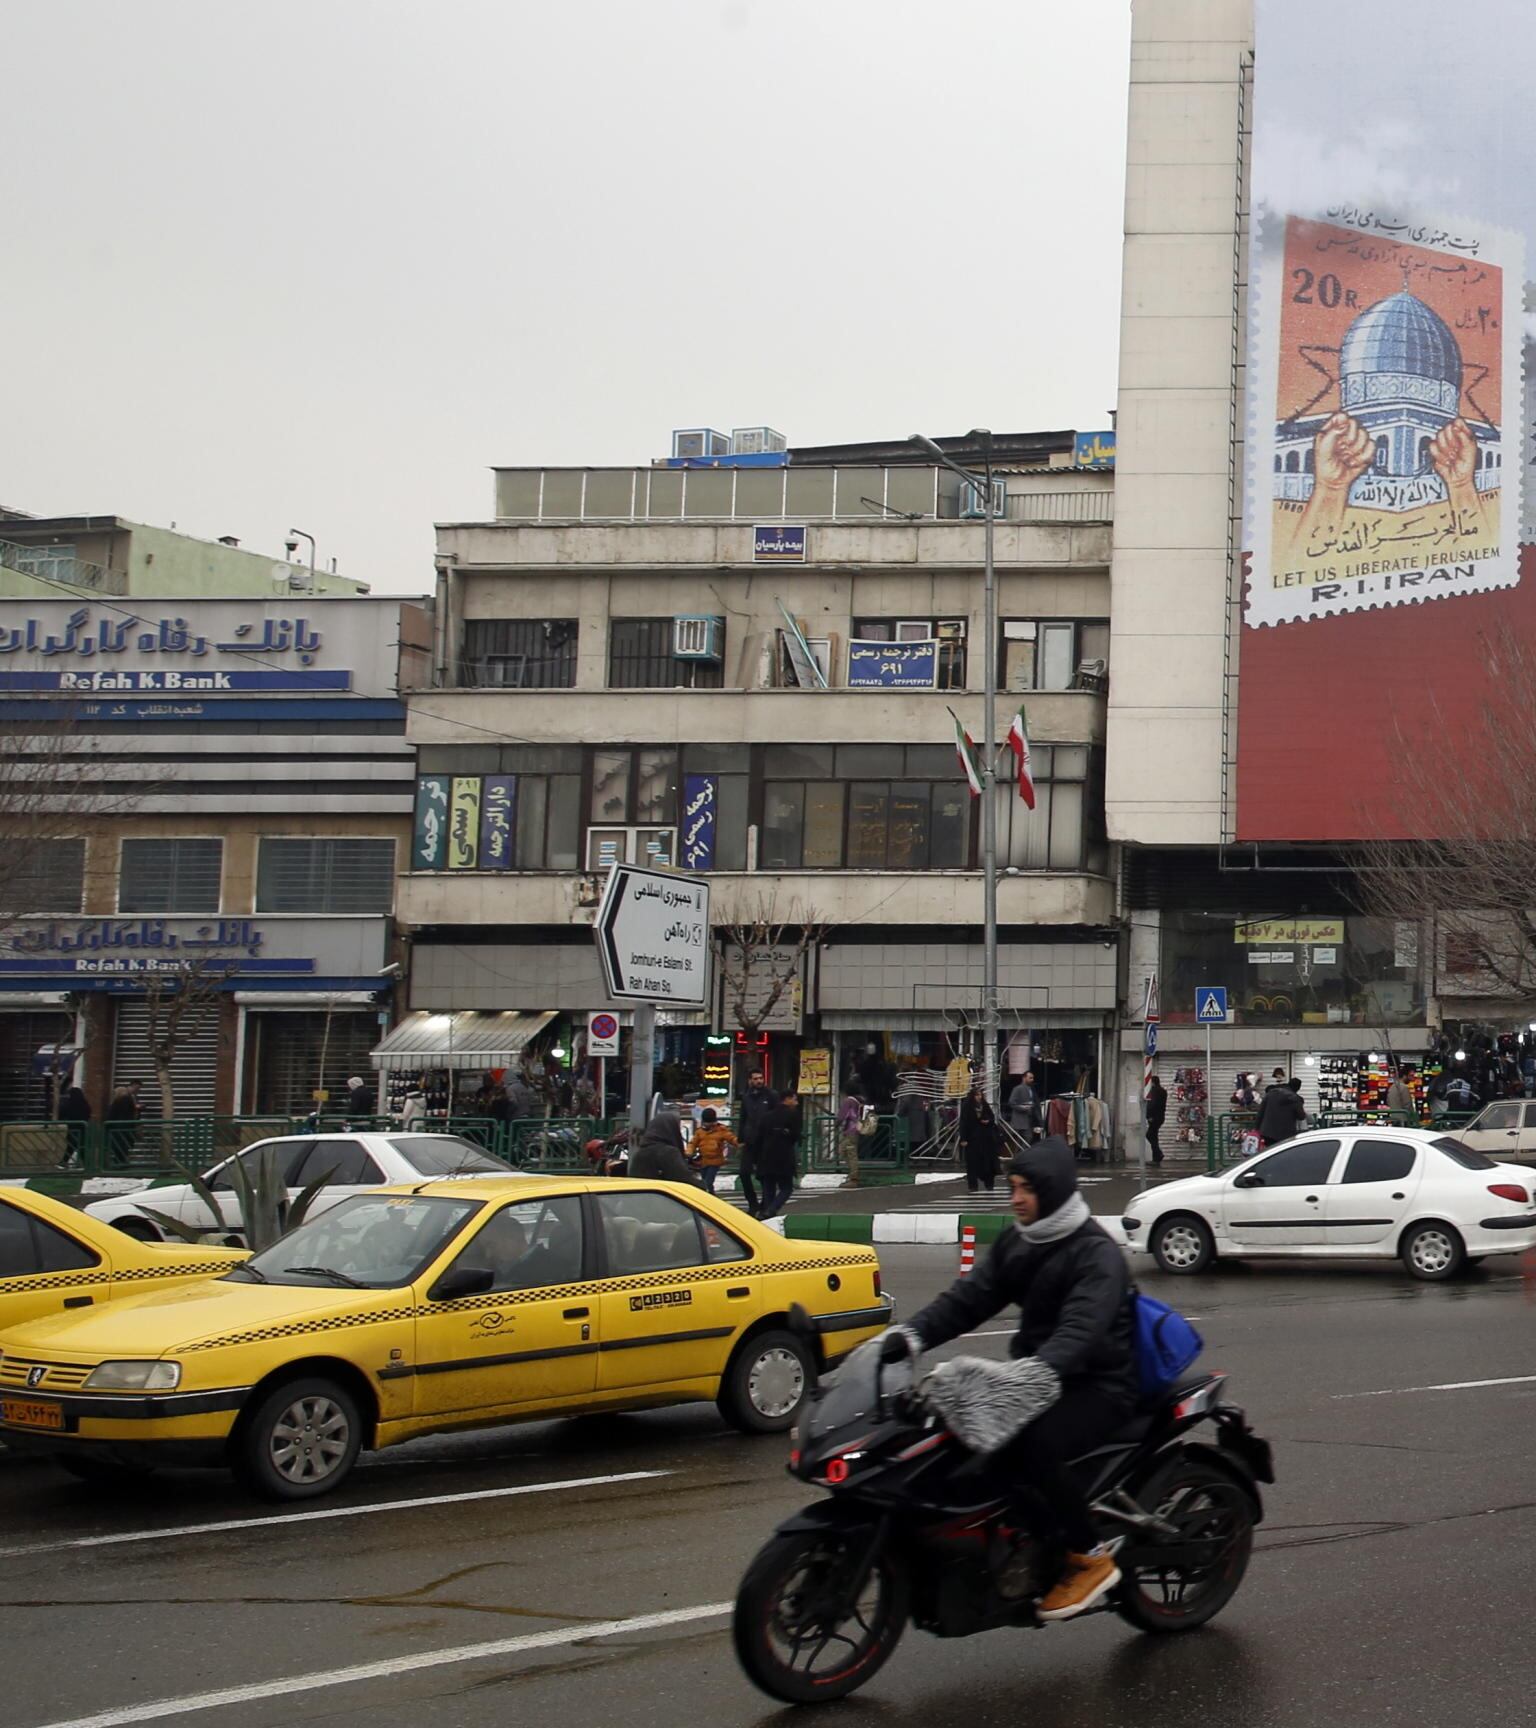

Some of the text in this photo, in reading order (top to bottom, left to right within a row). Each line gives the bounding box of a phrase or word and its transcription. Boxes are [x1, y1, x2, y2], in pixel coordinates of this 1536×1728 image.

[1292, 268, 1342, 308] 20
[1273, 546, 1501, 589] LET US LIBERATE JERUSALEM
[1384, 564, 1476, 590] IRAN
[138, 617, 208, 656] رفاه
[59, 672, 132, 691] Refah
[75, 959, 125, 975] Refah
[663, 954, 684, 969] Eslami
[629, 975, 643, 990] Rah
[643, 976, 661, 992] Ahan
